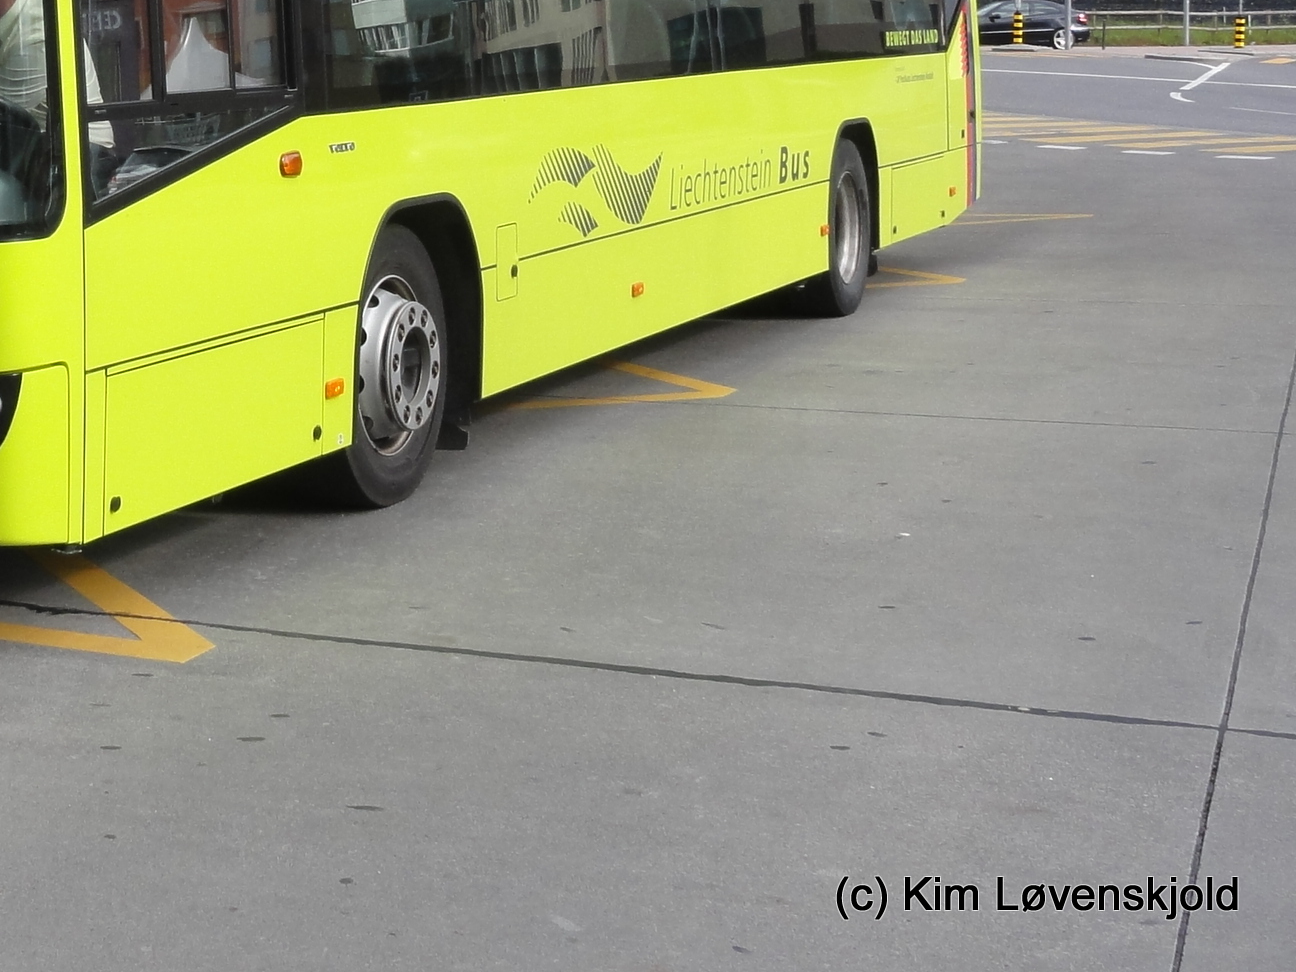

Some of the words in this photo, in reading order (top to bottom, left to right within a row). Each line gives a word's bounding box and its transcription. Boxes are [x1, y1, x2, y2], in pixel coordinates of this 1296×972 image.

[885, 30, 910, 47] BEWEGT
[910, 29, 923, 45] DAS
[923, 28, 939, 44] LAND
[670, 148, 772, 210] Liechtenstein
[778, 146, 810, 184] Bus
